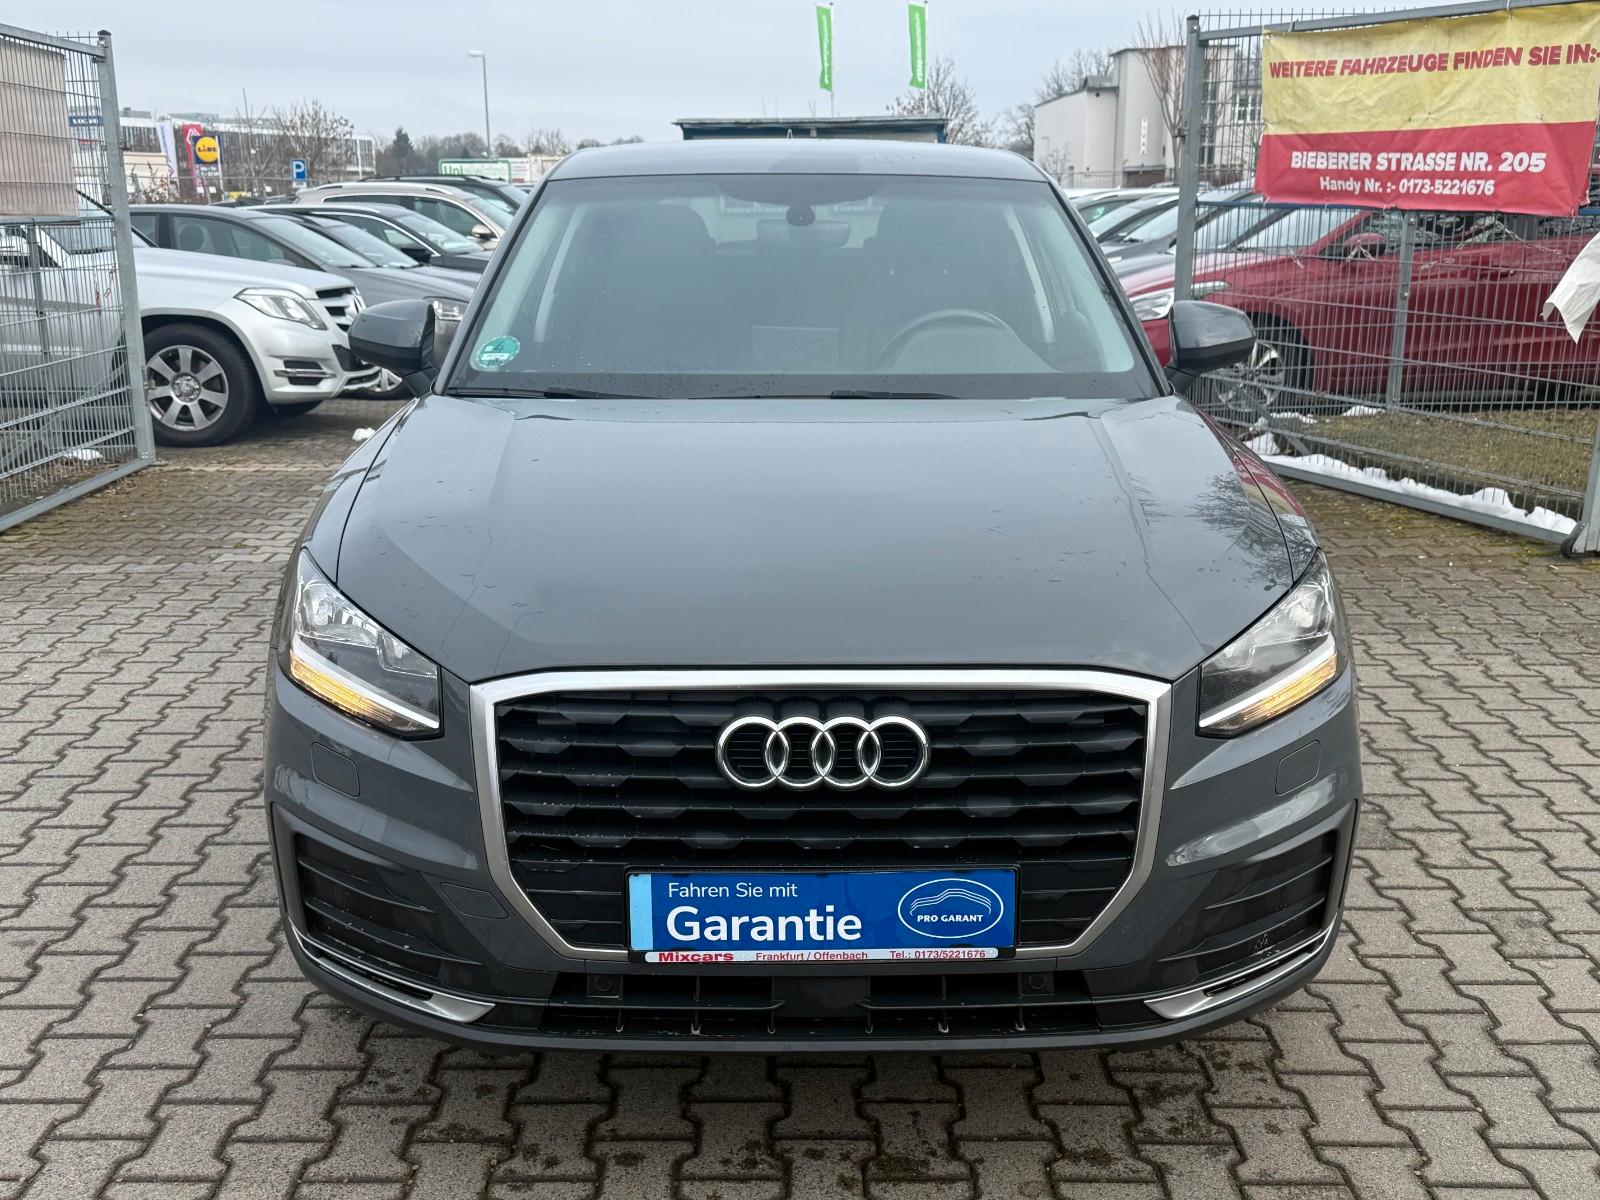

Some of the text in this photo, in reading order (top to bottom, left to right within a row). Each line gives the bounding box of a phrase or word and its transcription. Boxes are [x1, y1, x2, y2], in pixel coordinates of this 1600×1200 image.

[1269, 60, 1338, 78] WEITERE
[1339, 53, 1449, 76] FAHRZEUGE
[1453, 47, 1523, 70] FINDEN
[1528, 45, 1562, 66] SIE
[293, 161, 305, 179] P
[1291, 151, 1547, 172] BIEBERER STRASSE NR. 205
[1320, 176, 1361, 194] Handy
[1364, 178, 1383, 193] Nr.
[1399, 179, 1495, 195] 0173-5221676
[668, 882, 798, 898] Fahren Sie mit
[666, 905, 862, 942] Garantie
[917, 914, 984, 923] PRO GARANT
[658, 951, 734, 963] Mixcars
[755, 951, 803, 962] Frankfurt
[813, 951, 868, 961] Offenbach
[890, 950, 911, 960] Tel.:
[914, 950, 986, 960] 0173/5221676
